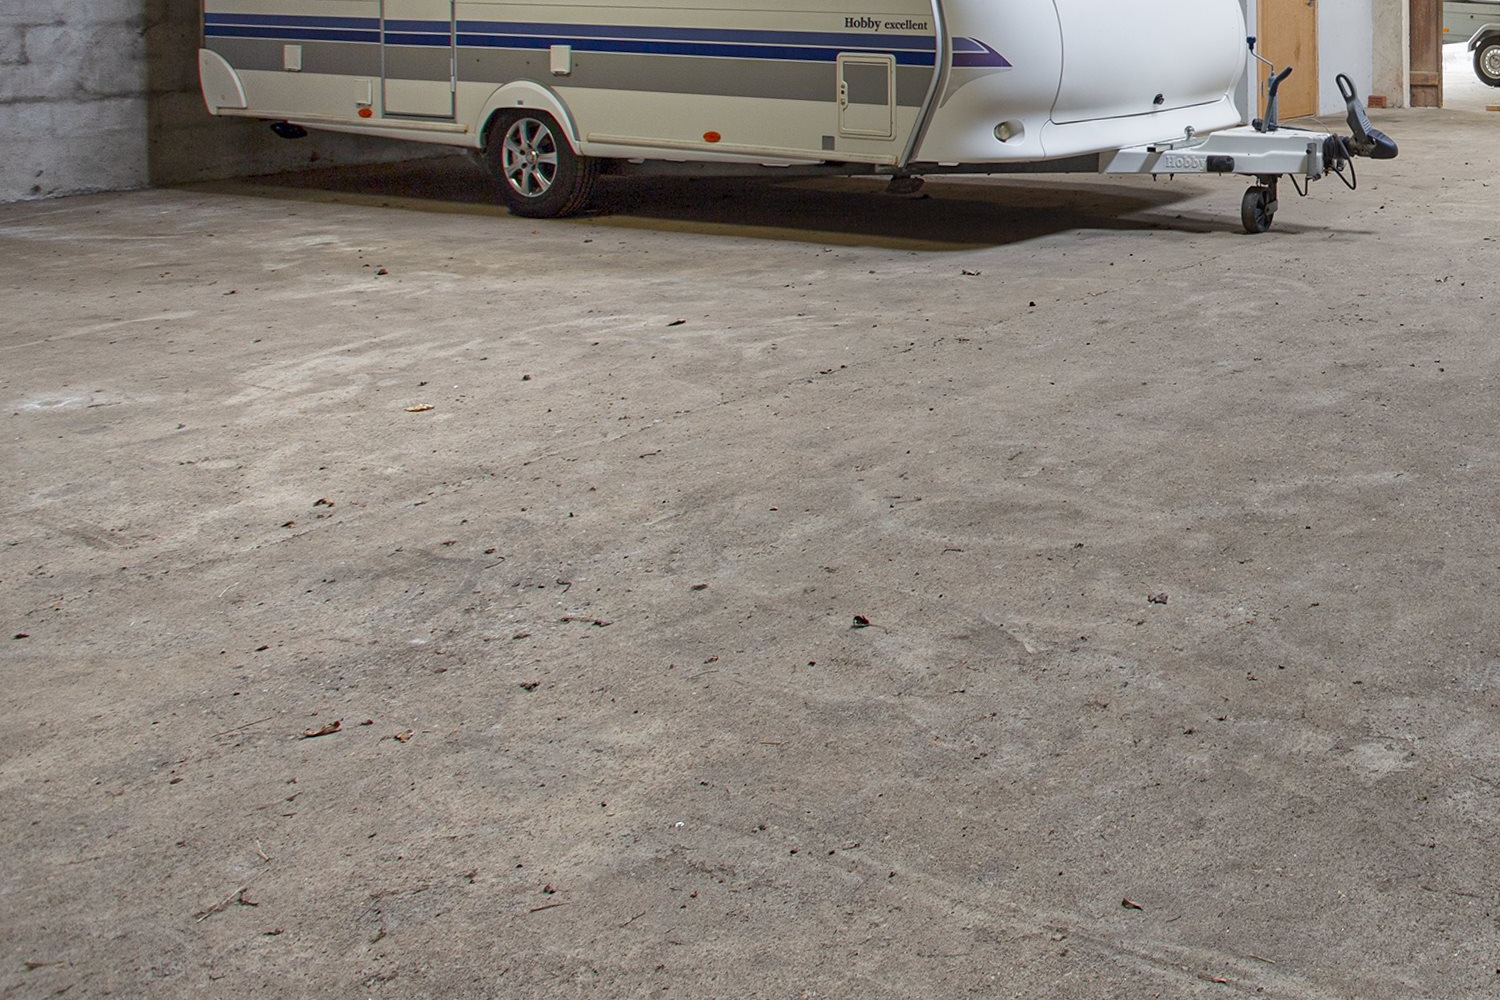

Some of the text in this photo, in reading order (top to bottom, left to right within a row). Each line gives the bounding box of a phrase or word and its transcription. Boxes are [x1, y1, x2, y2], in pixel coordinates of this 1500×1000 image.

[844, 16, 928, 32] Hobby excellent
[1165, 155, 1207, 171] Hobby
